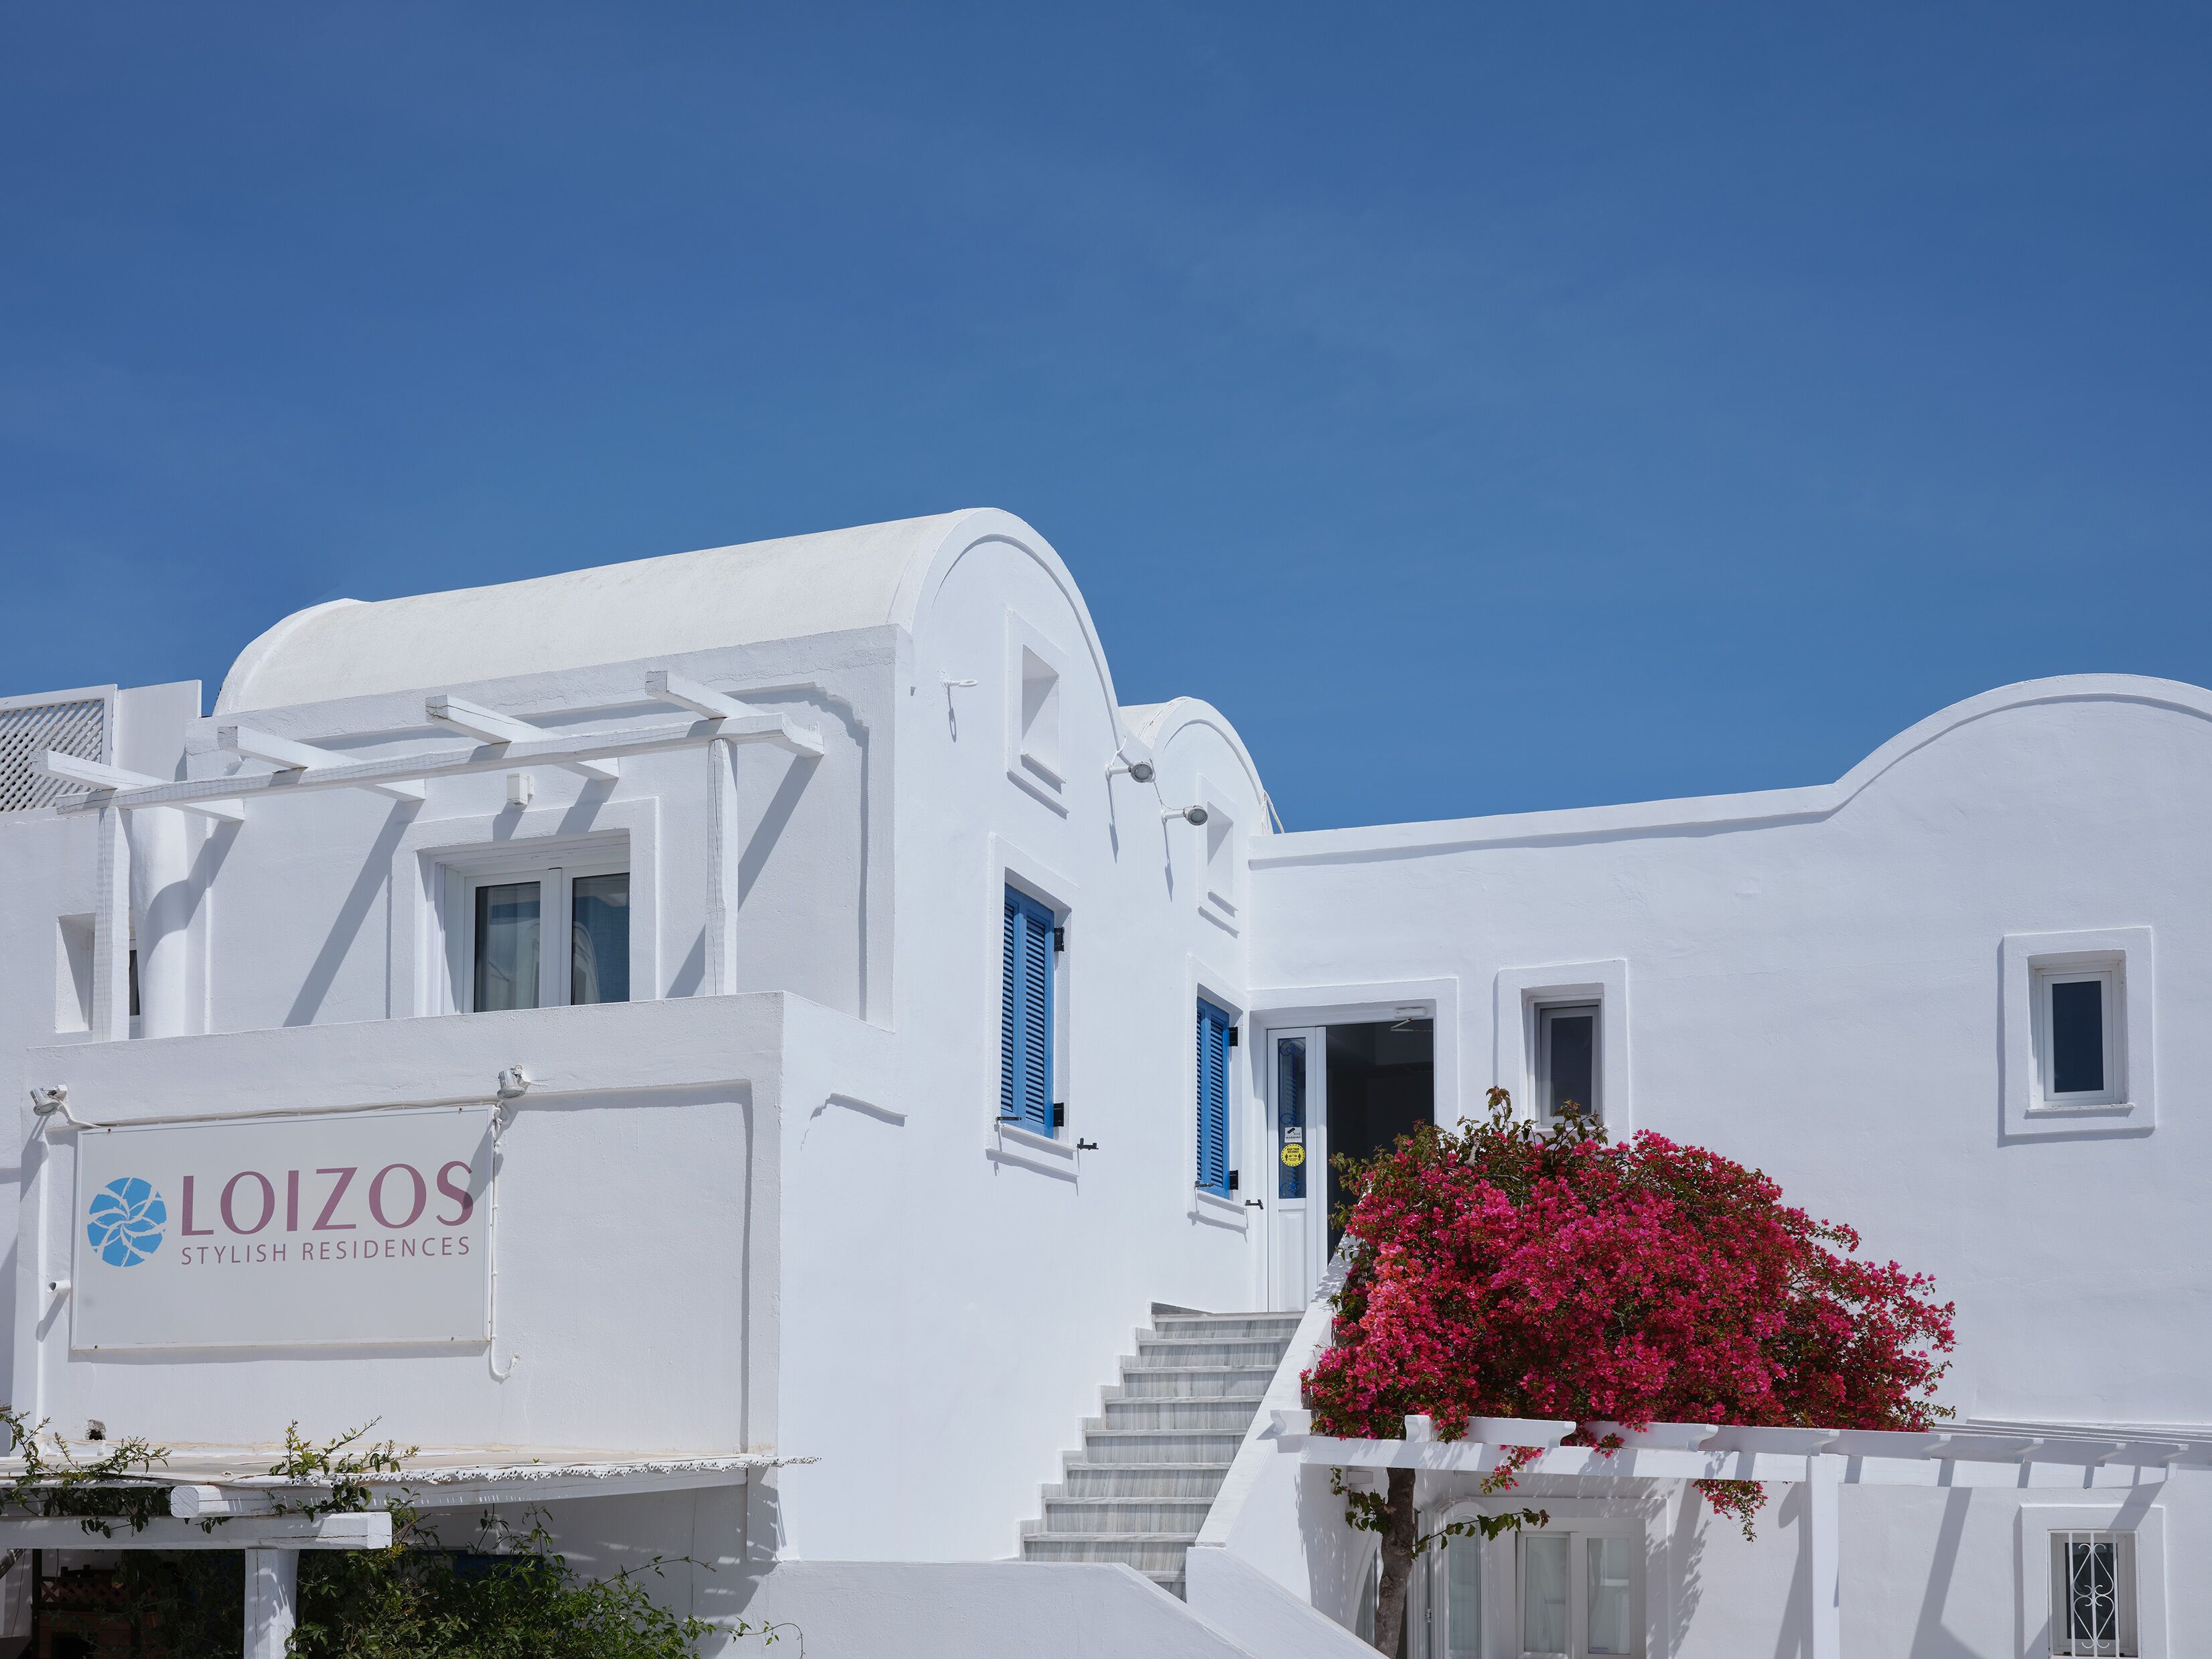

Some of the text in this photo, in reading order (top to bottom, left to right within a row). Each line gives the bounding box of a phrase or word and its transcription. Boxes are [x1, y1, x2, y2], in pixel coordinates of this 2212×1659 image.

[182, 1161, 474, 1236] LOIZOS
[182, 1236, 470, 1265] STYLISH RESIDENCES
